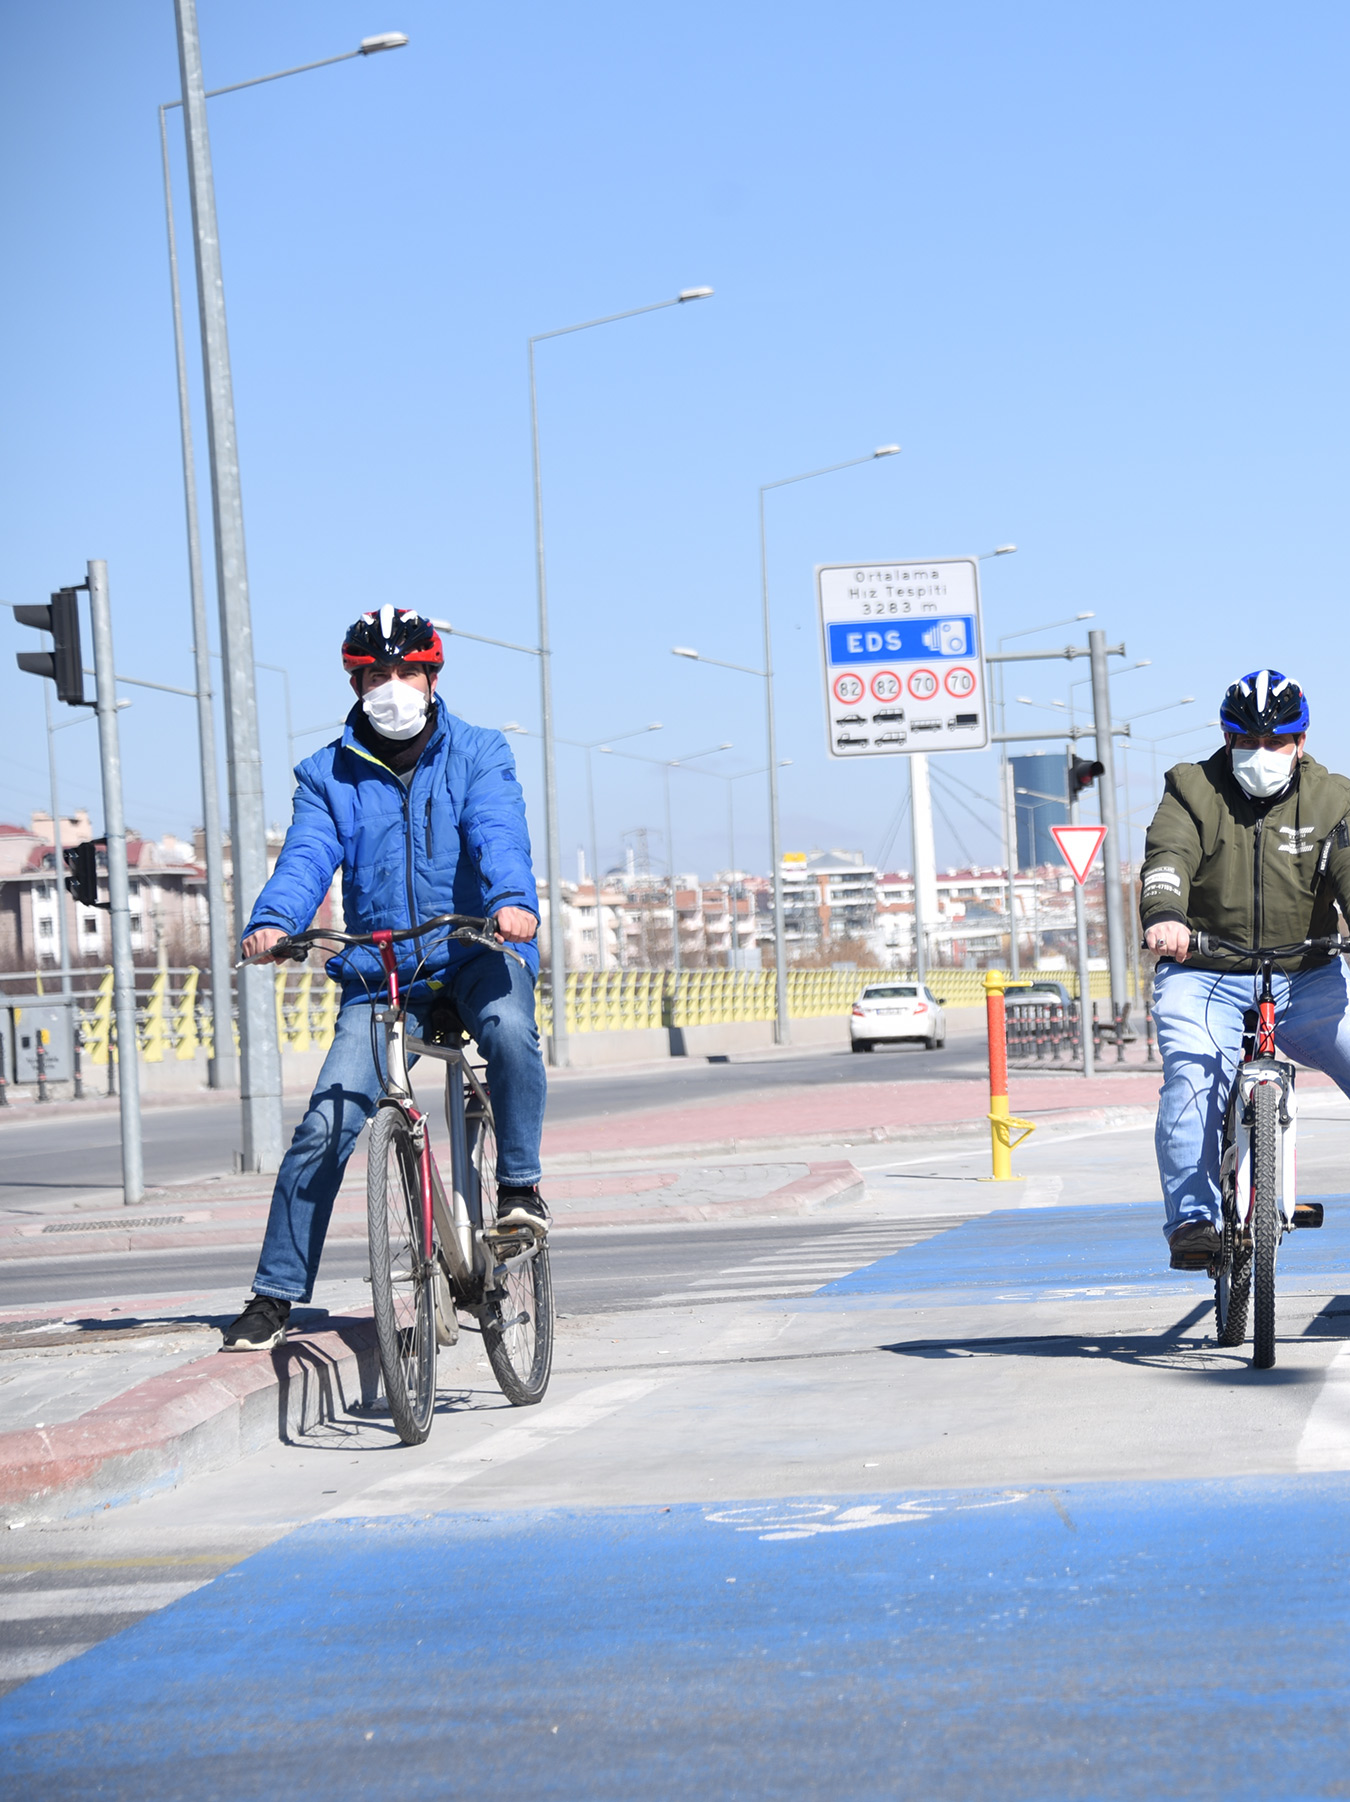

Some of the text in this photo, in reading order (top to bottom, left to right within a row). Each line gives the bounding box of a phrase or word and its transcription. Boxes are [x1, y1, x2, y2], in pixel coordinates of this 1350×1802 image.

[856, 570, 940, 583] Ortalama
[849, 585, 948, 600] Hız Tespiti
[863, 602, 938, 615] 3283 m
[846, 630, 902, 653] EDS
[839, 675, 971, 697] 82 82 70 70
